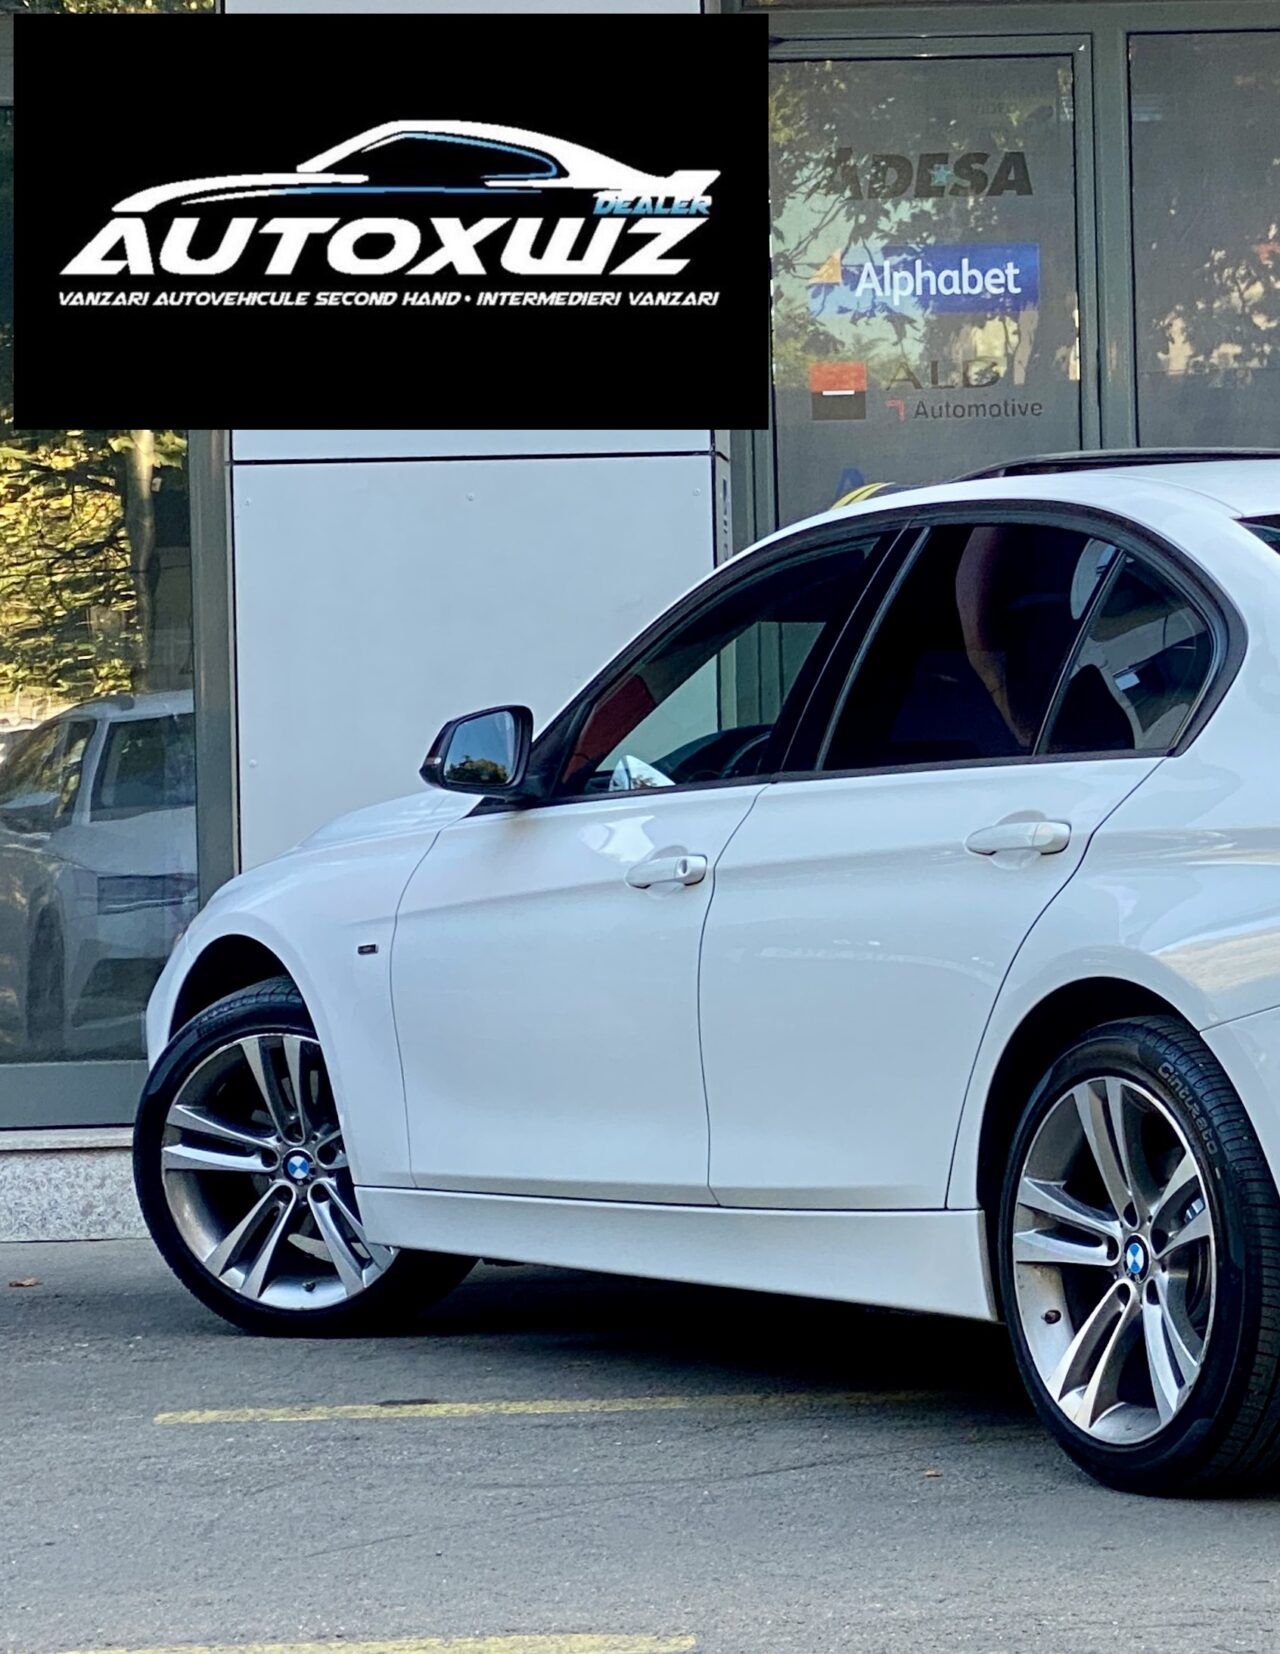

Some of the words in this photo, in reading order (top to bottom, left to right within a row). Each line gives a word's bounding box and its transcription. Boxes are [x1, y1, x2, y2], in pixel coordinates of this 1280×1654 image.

[826, 148, 1033, 199] ADESA
[855, 258, 1021, 304] Alphabet
[913, 398, 1043, 420] Automotive
